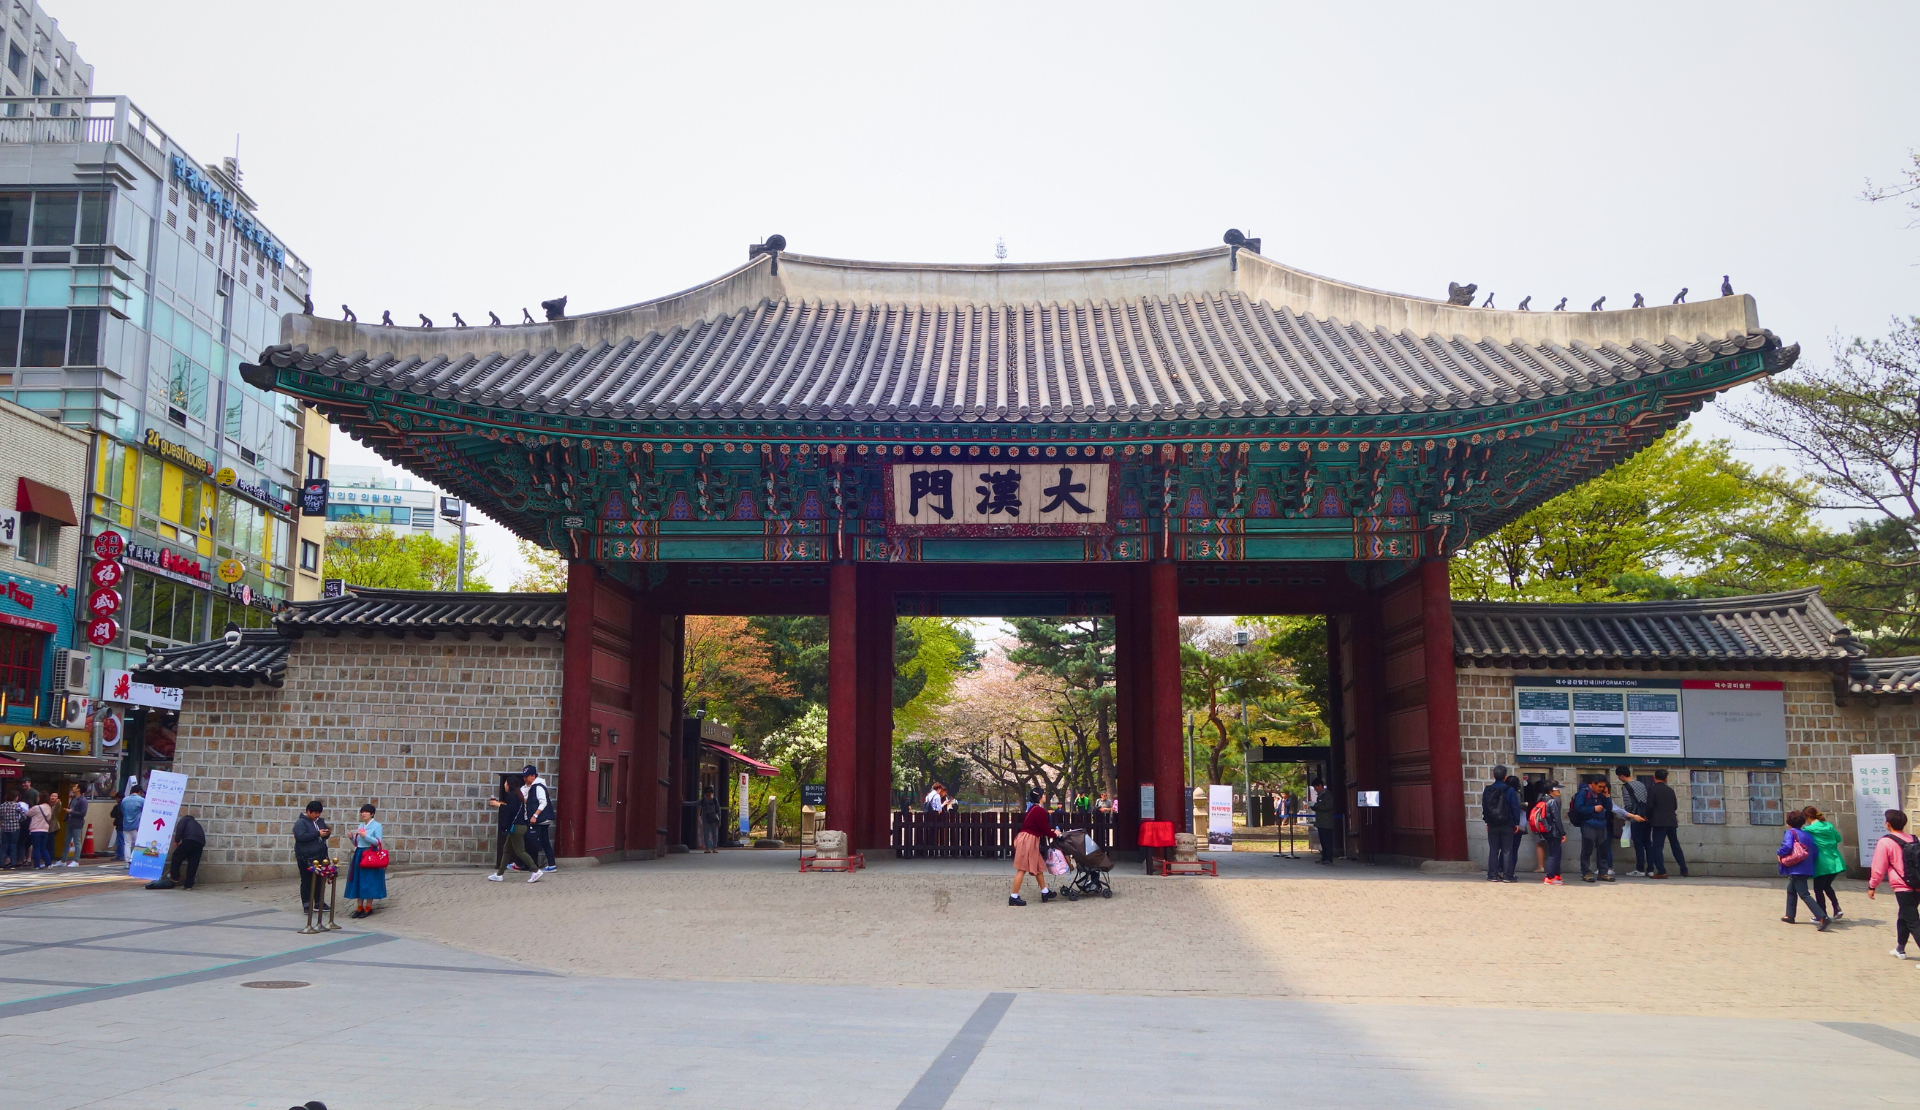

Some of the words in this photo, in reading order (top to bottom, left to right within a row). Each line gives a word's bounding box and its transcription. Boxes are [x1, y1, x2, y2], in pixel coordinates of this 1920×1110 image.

[146, 428, 160, 449] 24
[160, 440, 207, 472] guesthouse
[360, 493, 403, 504] 의원회관
[909, 467, 1096, 520] 大漢門
[0, 515, 15, 540] 집
[1861, 787, 1891, 796] 음악회
